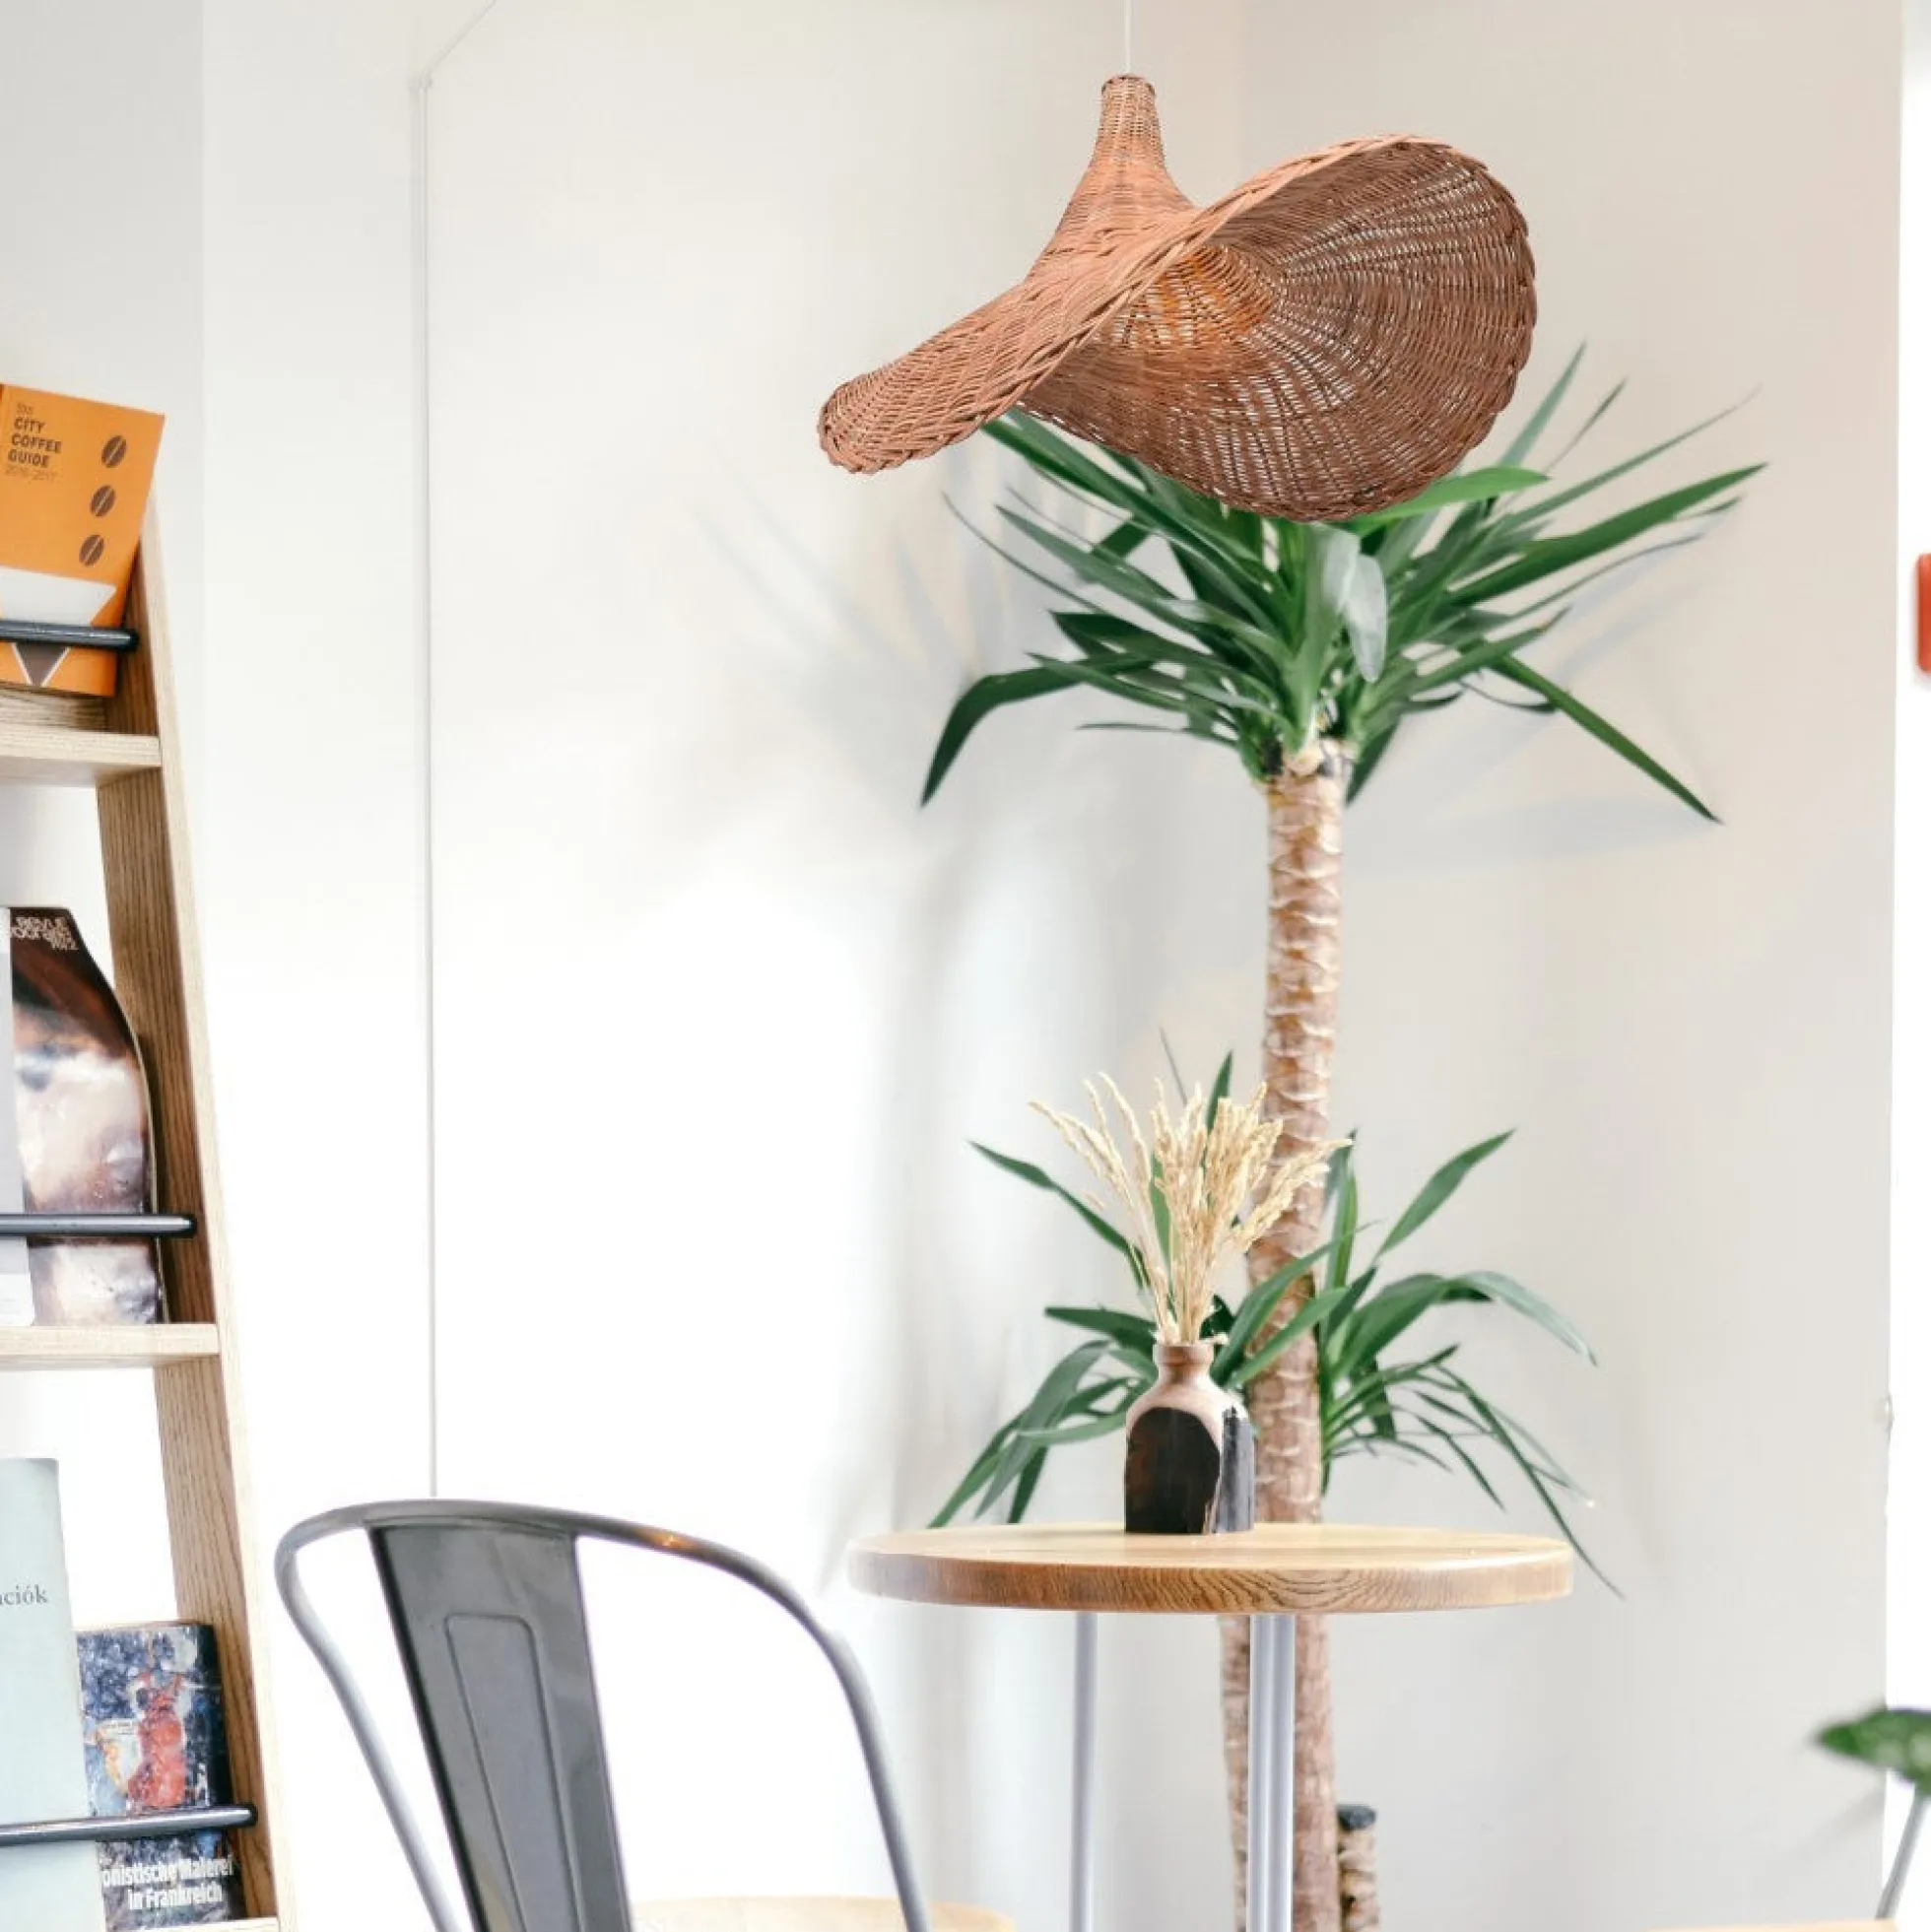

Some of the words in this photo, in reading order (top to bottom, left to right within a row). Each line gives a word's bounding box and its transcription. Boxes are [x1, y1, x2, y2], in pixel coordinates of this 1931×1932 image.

[14, 417, 45, 433] CITY
[11, 433, 62, 453] COFFEE
[8, 449, 50, 468] GUIDE
[0, 1583, 47, 1606] ciók
[178, 1853, 233, 1880] Malerei
[128, 1887, 144, 1909] in
[145, 1881, 223, 1906] Frankreich
